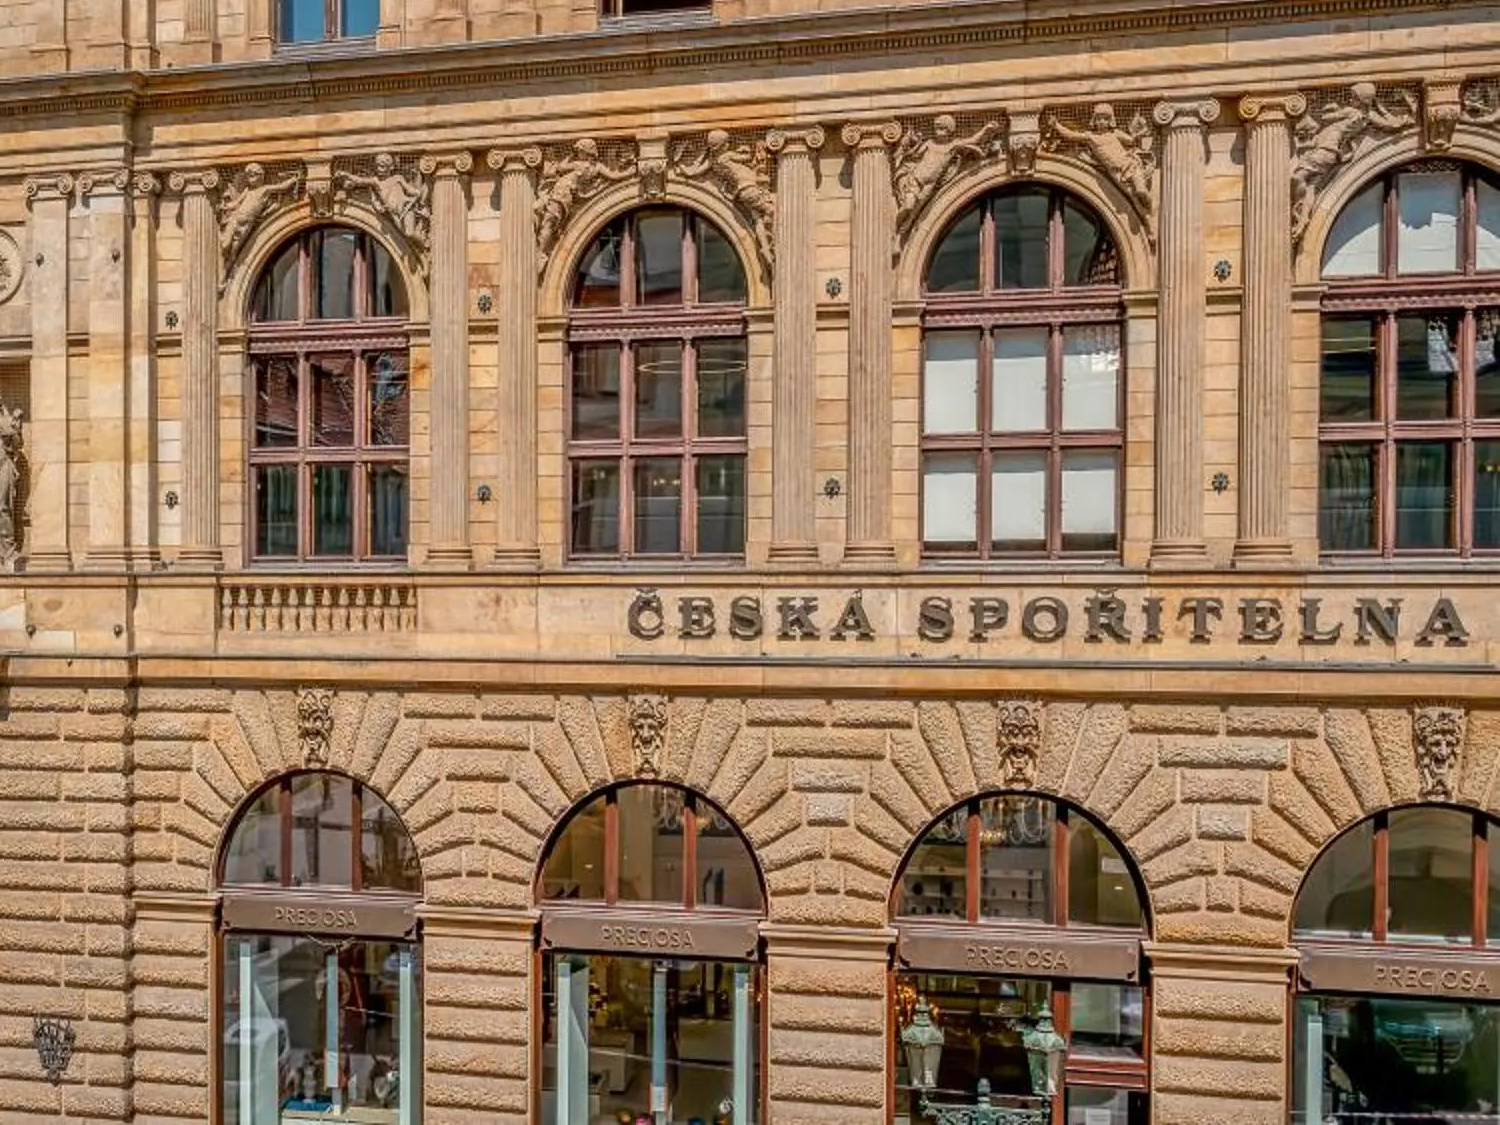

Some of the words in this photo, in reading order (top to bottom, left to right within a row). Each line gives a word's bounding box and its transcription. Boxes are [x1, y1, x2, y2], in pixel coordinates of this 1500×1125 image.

[628, 587, 876, 641] ČESKÁ
[917, 586, 1470, 648] SPOŘITELNA
[275, 906, 358, 929] PRECIOSA
[602, 925, 695, 949] PRECIOSA
[965, 945, 1069, 971] PRECIOSA
[1374, 965, 1492, 993] PRECIOSA
